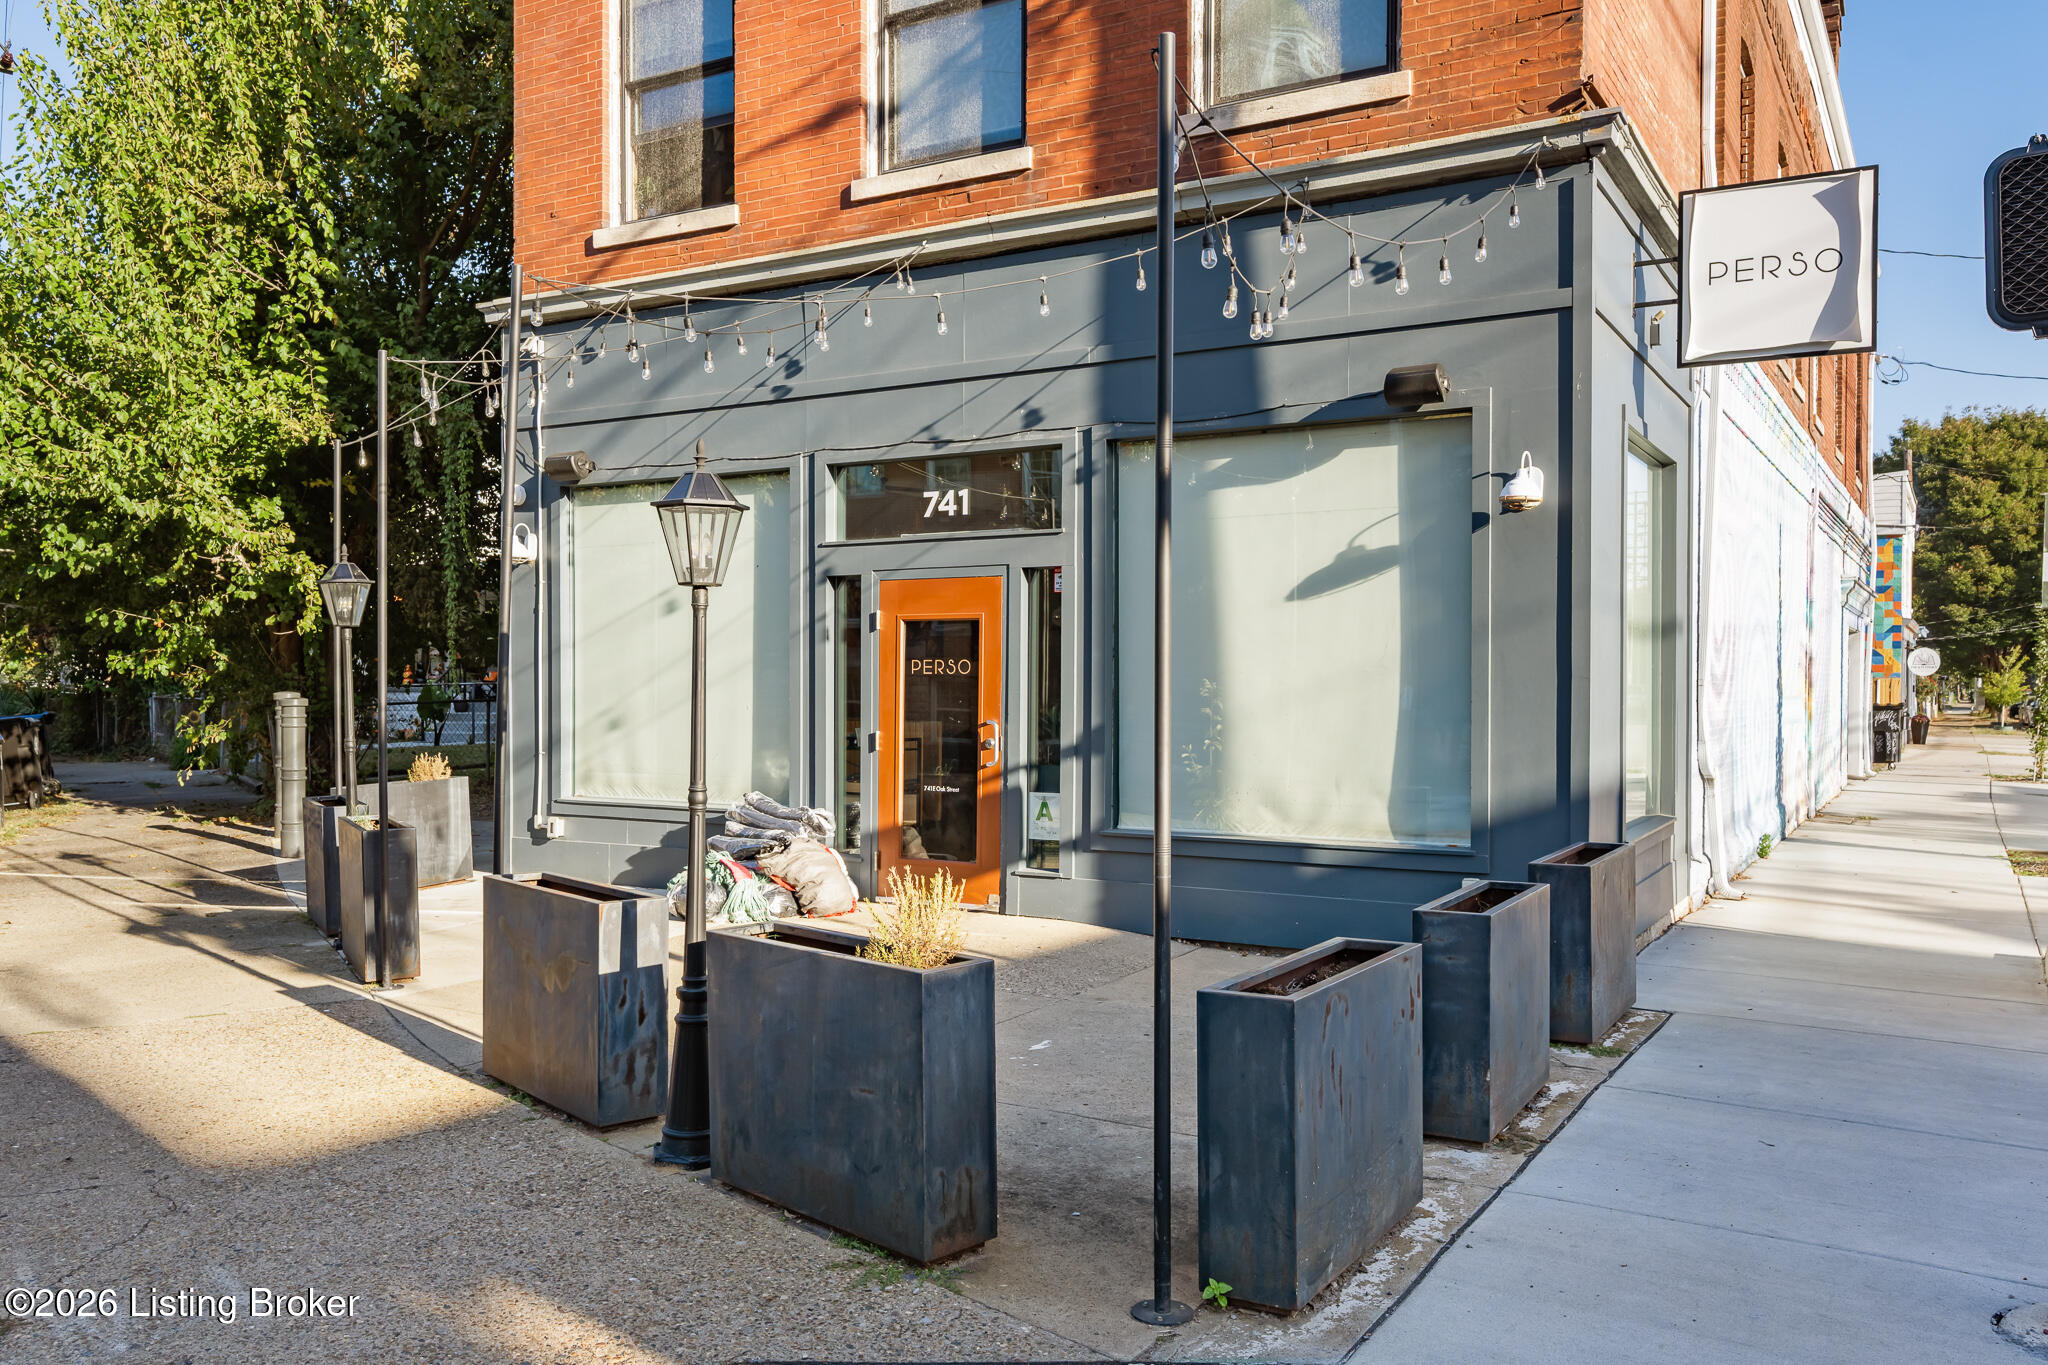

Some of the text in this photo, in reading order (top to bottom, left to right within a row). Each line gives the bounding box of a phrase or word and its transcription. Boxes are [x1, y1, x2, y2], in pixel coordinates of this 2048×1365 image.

[1708, 247, 1844, 286] PERSO
[923, 488, 969, 518] 741
[911, 658, 971, 675] PERSO
[1035, 801, 1053, 822] A
